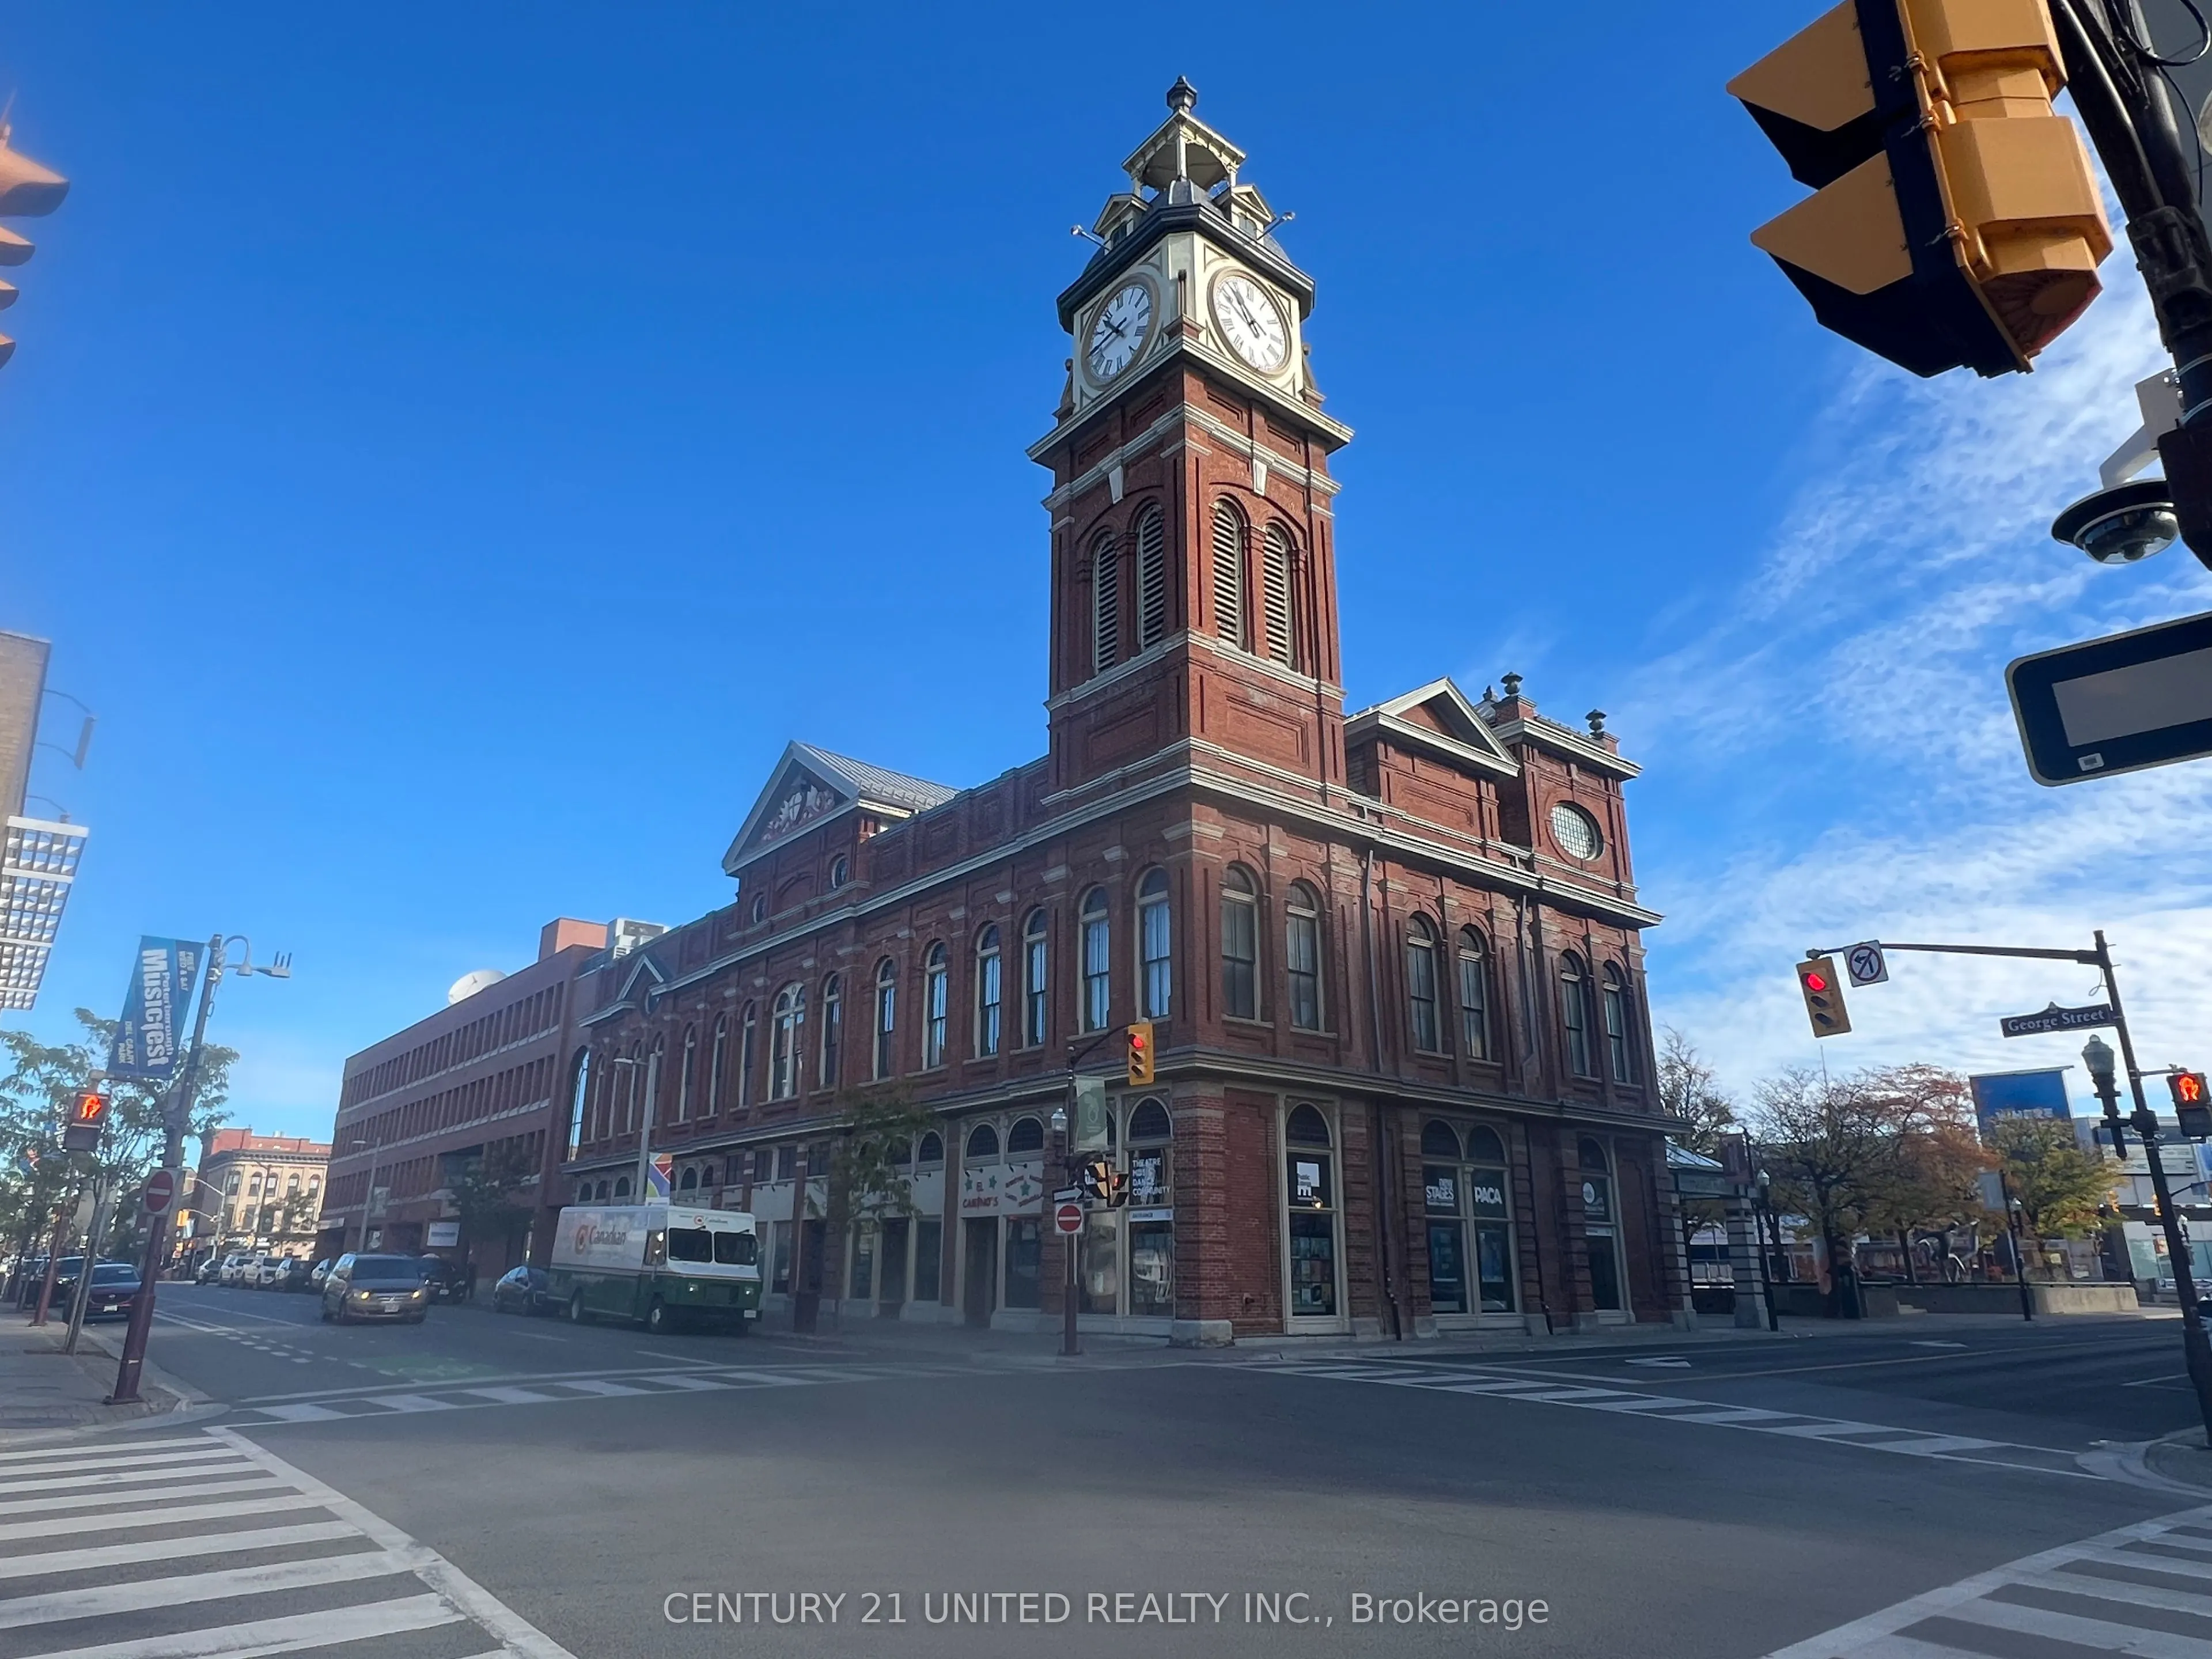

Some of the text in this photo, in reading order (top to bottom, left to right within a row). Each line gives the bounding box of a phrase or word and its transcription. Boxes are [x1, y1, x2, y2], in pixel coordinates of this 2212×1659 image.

[141, 948, 169, 1067] Musicfest
[162, 971, 174, 1055] Peterborough
[2008, 1009, 2105, 1032] George Street
[1132, 1157, 1161, 1168] THEATRE
[1132, 1185, 1171, 1196] COMMUNITY
[1426, 1185, 1503, 1205] STAGES PACA
[589, 1225, 627, 1246] Canadian
